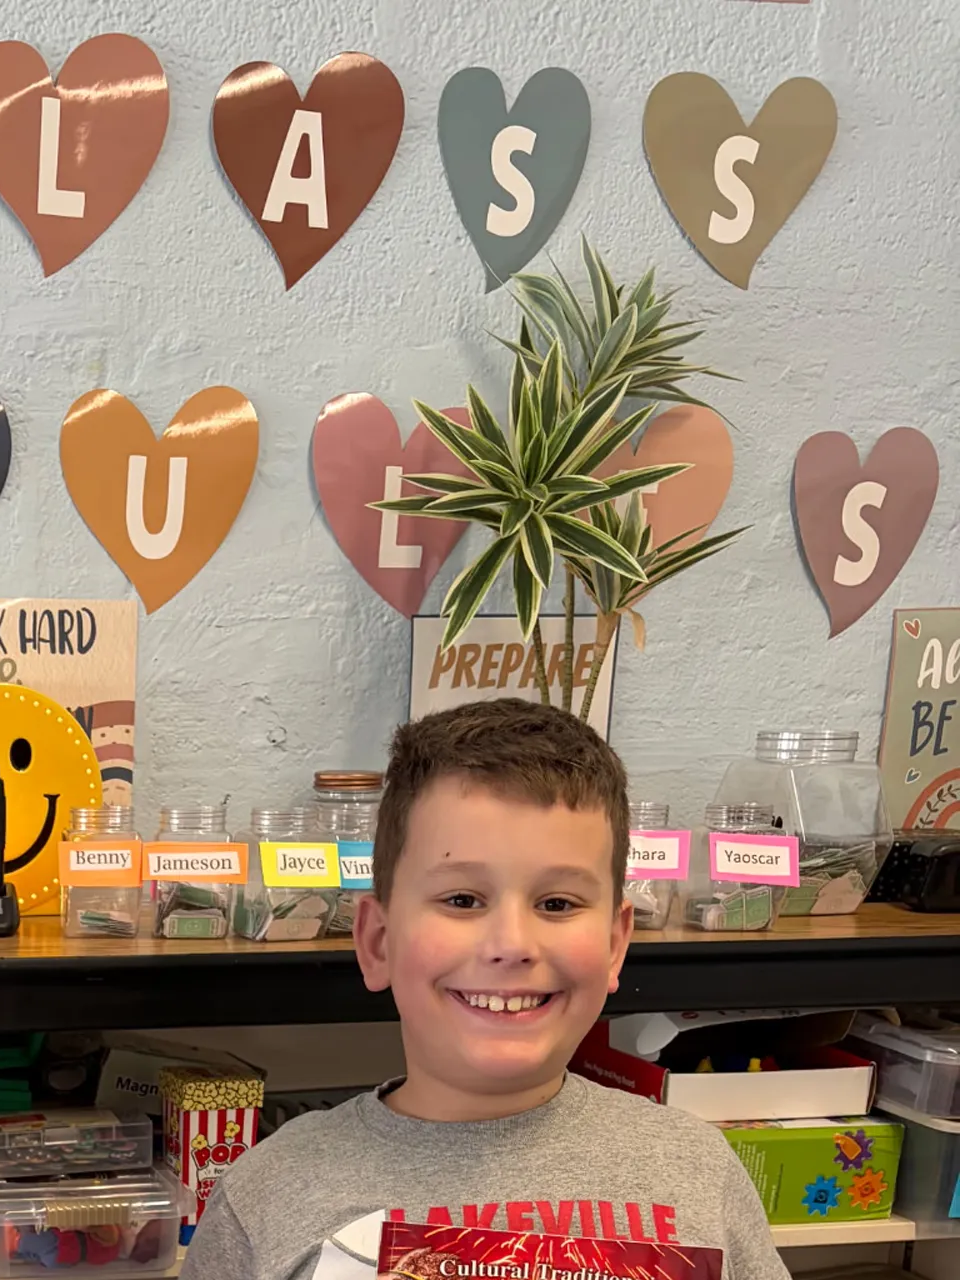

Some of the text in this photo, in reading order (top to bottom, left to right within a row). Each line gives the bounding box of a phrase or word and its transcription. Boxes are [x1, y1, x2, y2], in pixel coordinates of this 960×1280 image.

[19, 606, 97, 656] HARD
[909, 700, 957, 758] BE
[75, 850, 131, 866] Benny
[279, 853, 326, 872] Jayce
[628, 847, 666, 861] hara
[724, 849, 781, 865] Yaoscar
[153, 854, 233, 874] Jameson
[341, 860, 371, 875] Vin
[440, 1258, 530, 1280] Cultural
